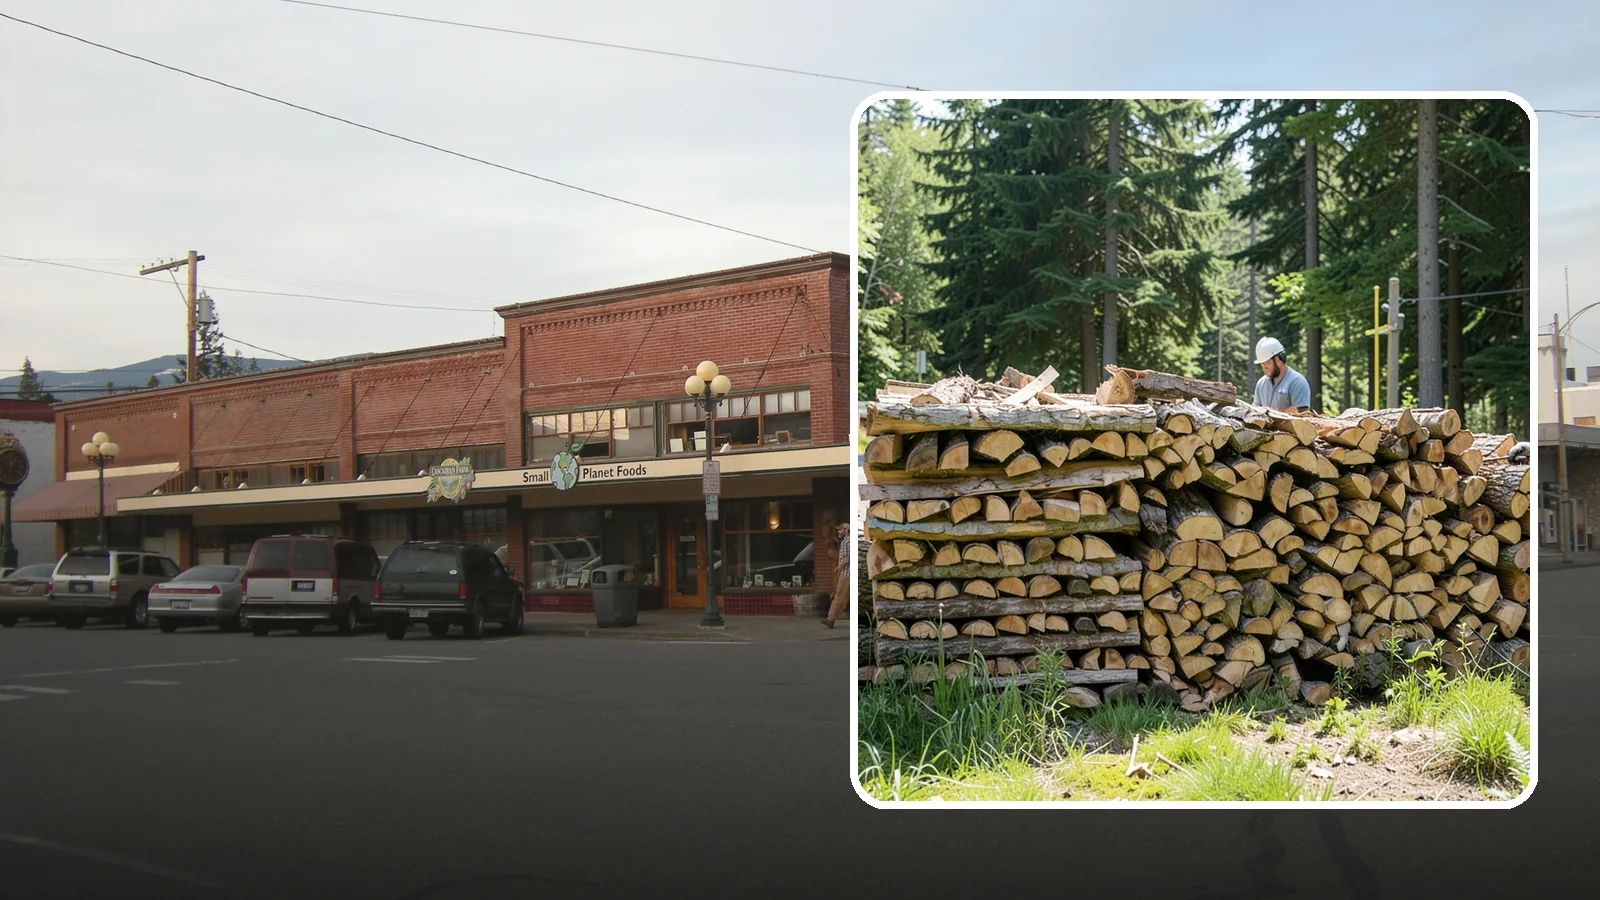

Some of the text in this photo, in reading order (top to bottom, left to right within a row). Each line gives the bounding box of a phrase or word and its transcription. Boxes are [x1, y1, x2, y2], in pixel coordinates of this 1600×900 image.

[523, 464, 647, 483] Small Planet Foods
